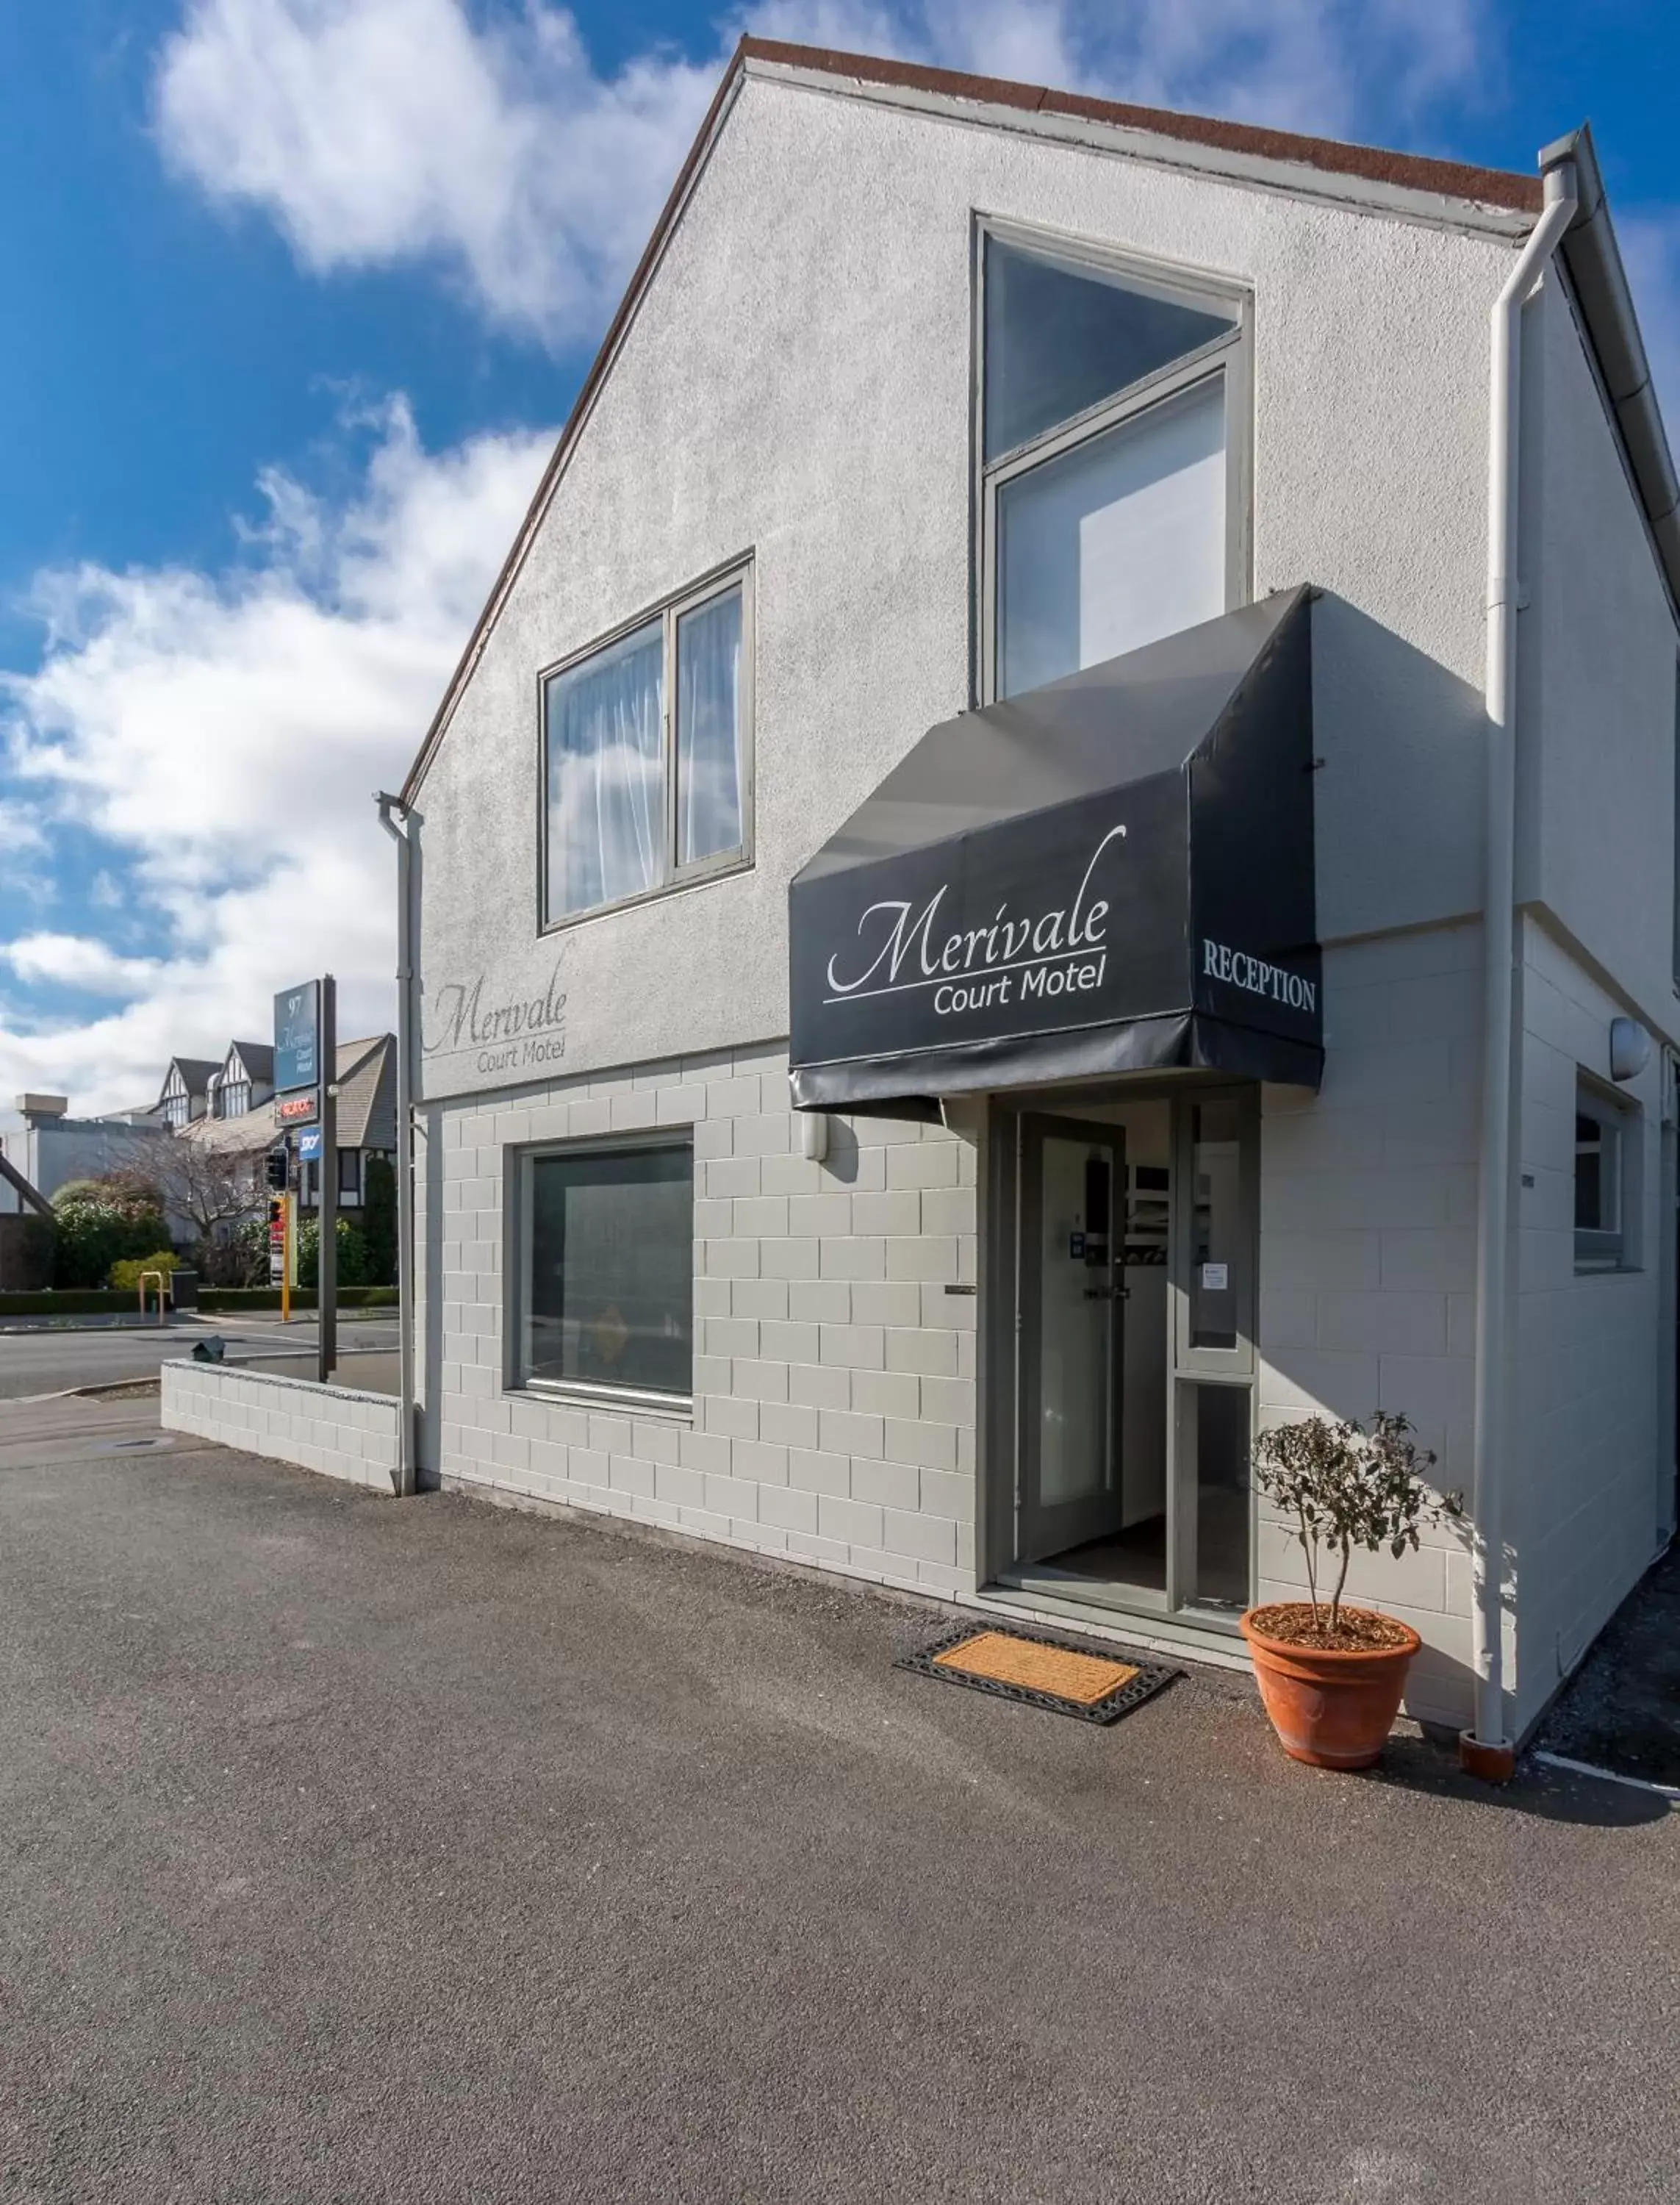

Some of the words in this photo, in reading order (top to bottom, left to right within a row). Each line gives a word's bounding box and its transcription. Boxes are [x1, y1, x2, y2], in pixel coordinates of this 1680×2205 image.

[827, 824, 1127, 992] Merivale
[422, 937, 576, 1052] Merivale
[934, 975, 1012, 1015] Court
[1019, 953, 1107, 1001] Motel
[1202, 938, 1316, 1014] RECEPTION
[477, 1046, 518, 1074] Court
[522, 1034, 565, 1066] Motel
